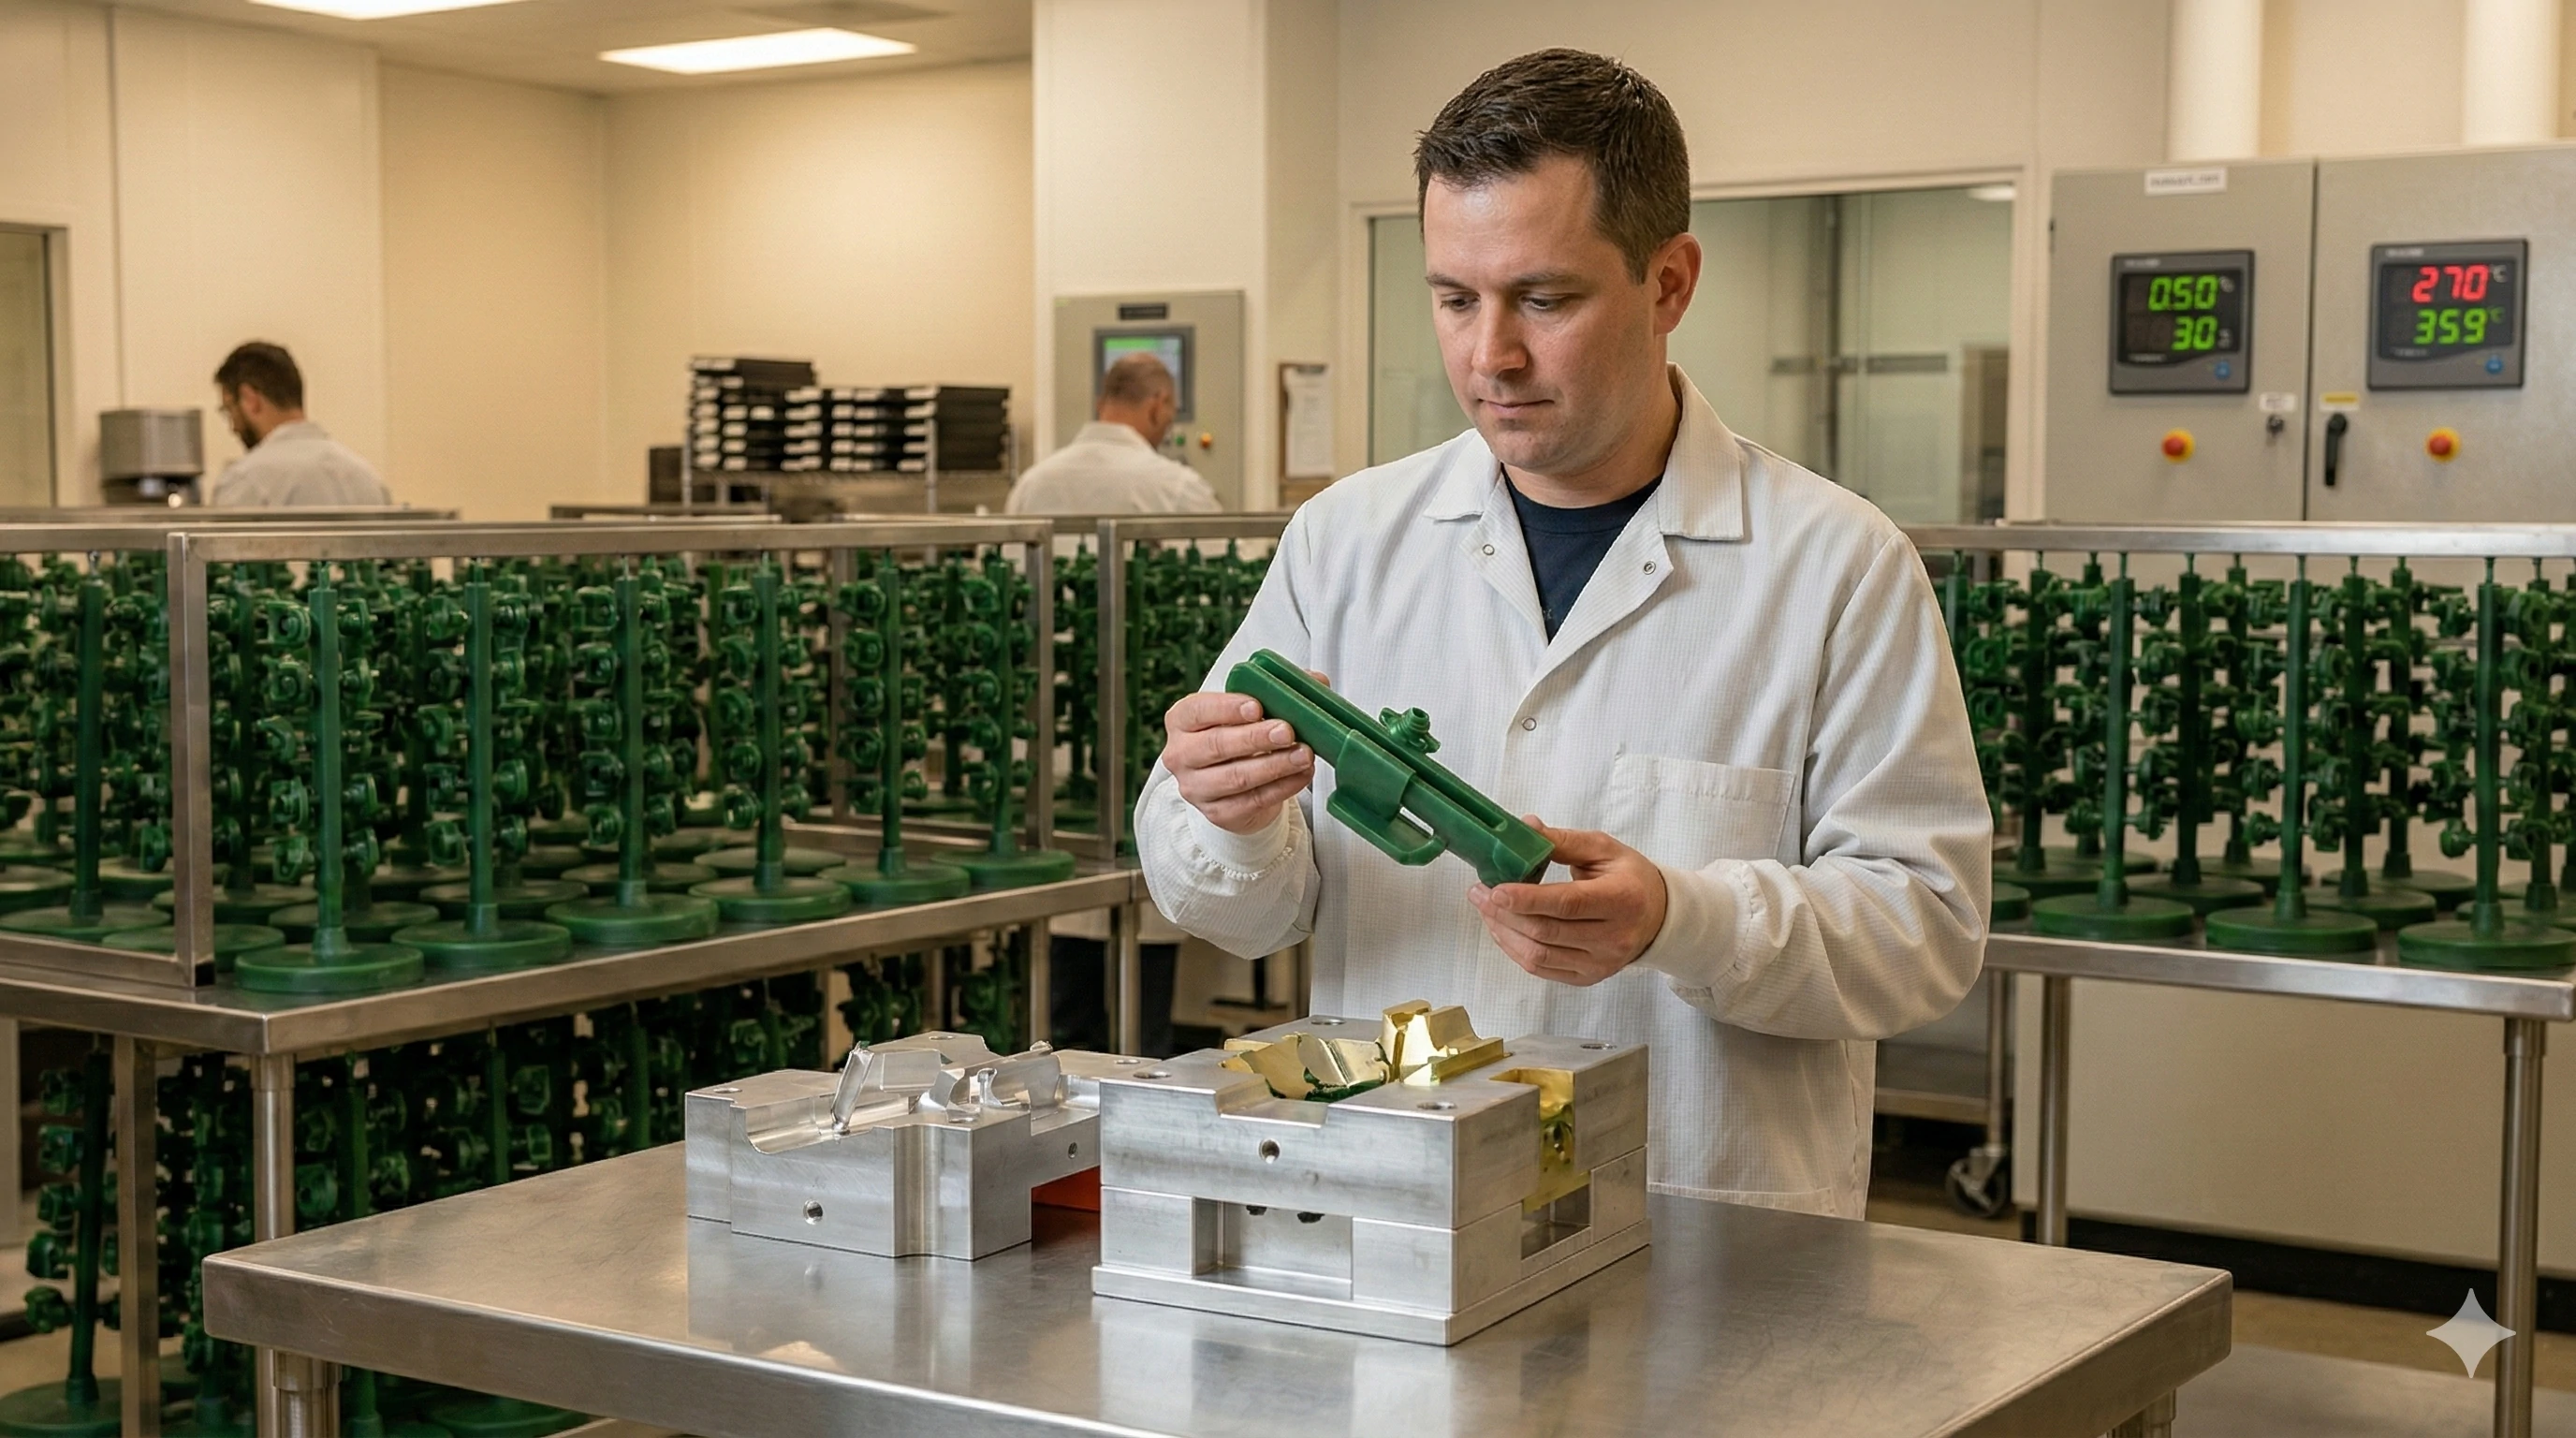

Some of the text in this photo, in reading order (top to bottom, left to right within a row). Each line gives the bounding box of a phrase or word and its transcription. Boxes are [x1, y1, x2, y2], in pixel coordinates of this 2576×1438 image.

[2412, 264, 2490, 303] 270
[2172, 315, 2217, 350] 30
[2412, 308, 2488, 345] 359
